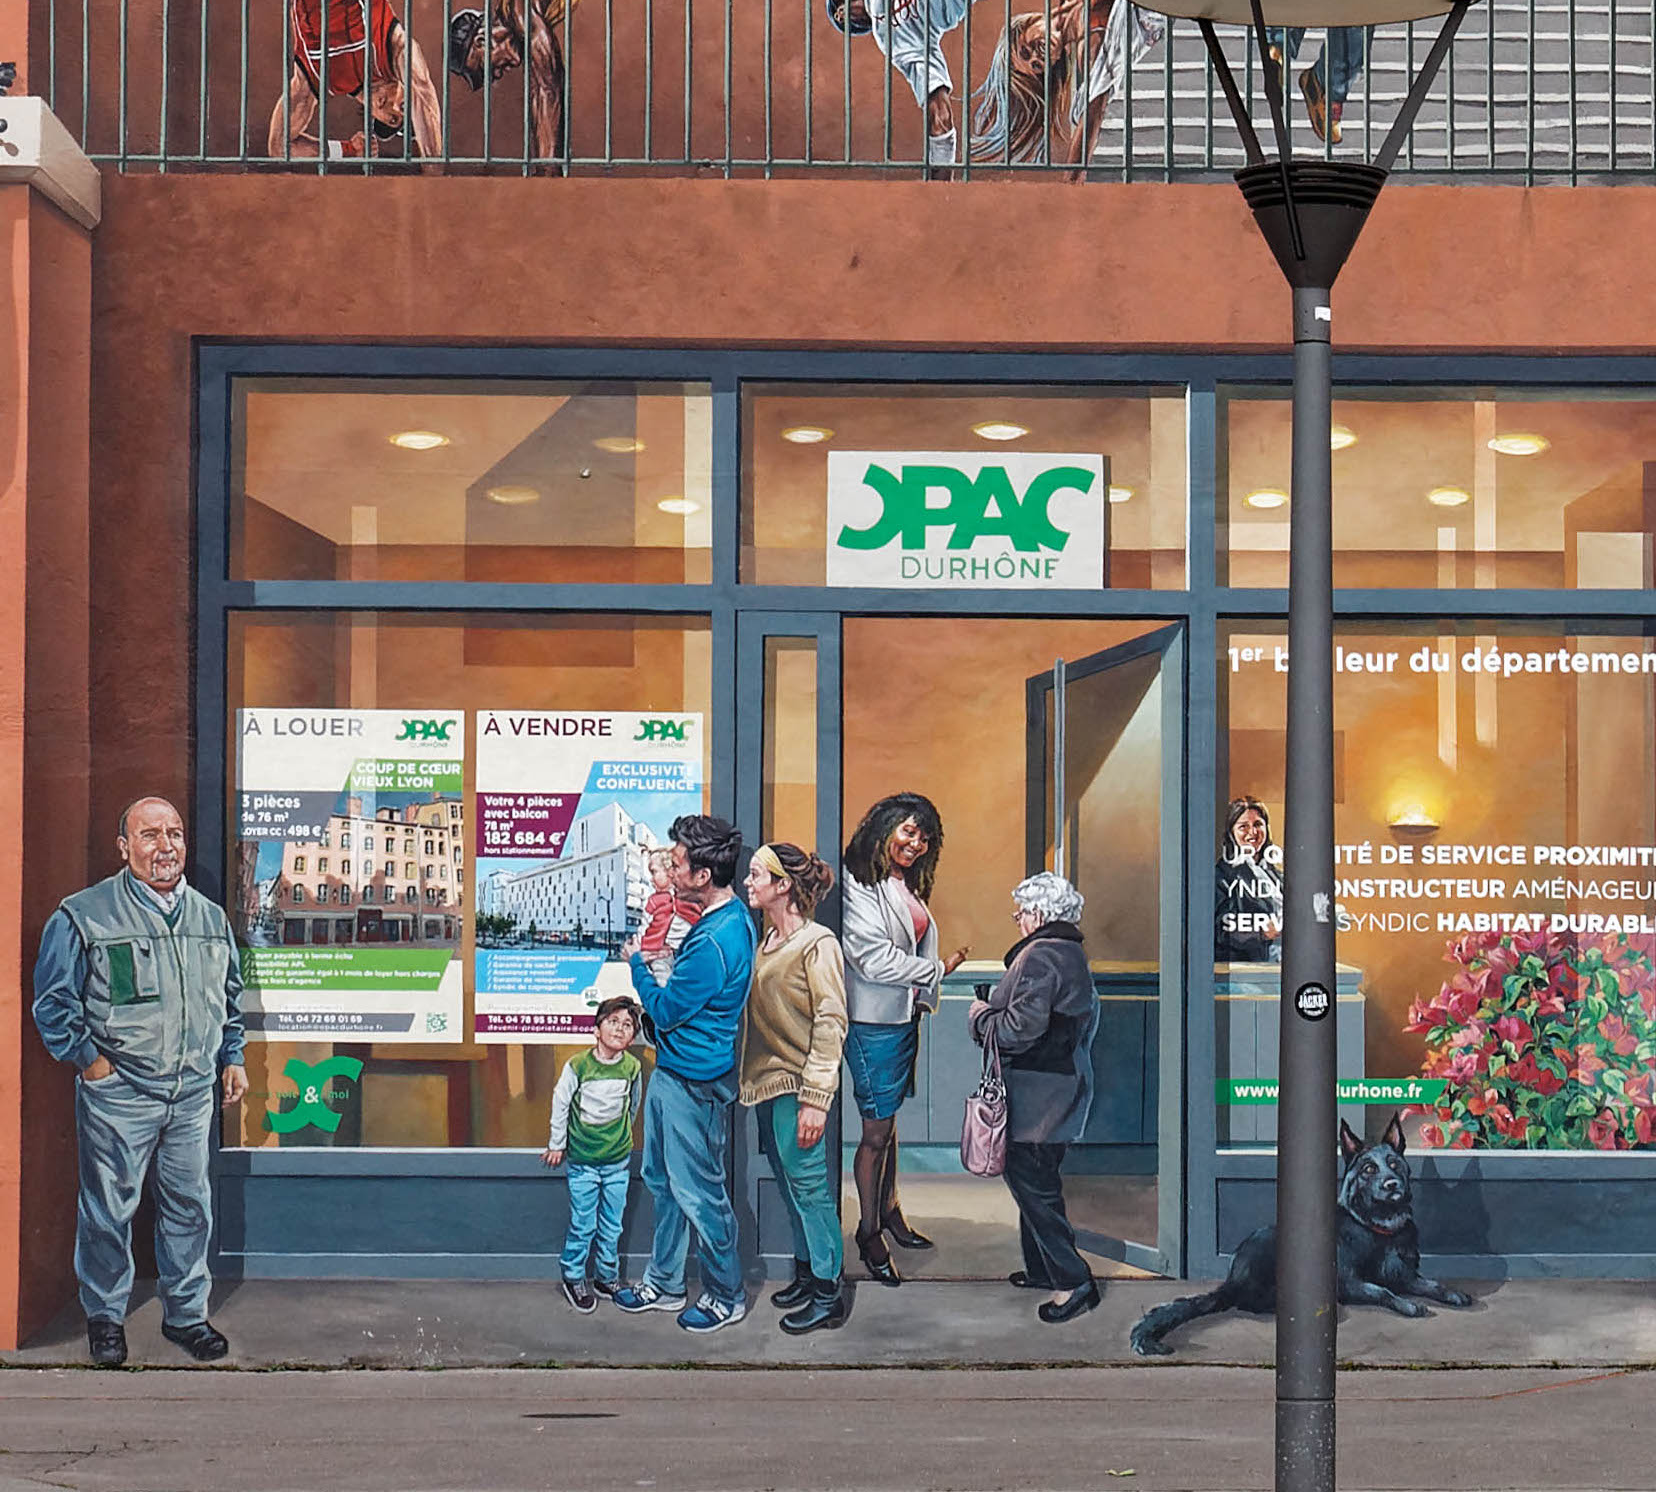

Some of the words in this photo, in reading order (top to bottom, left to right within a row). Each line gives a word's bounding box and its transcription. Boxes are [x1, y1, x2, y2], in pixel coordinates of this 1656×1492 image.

[1228, 646, 1263, 672] 1er
[1274, 646, 1397, 672] bleur
[1409, 647, 1449, 672] du
[244, 712, 262, 736] À
[274, 718, 364, 736] LOUER
[484, 712, 501, 736] À
[509, 718, 612, 736] VENDRE
[356, 763, 394, 775] COUP
[398, 763, 416, 775] DE
[352, 776, 393, 788] VIEUX
[398, 776, 434, 789] LYON
[596, 778, 695, 791] CONFLUENCE
[254, 793, 301, 810] pièces
[485, 796, 514, 807] Votre
[517, 796, 525, 807] 4
[527, 795, 563, 808] pièces
[257, 812, 272, 822] 76
[484, 810, 510, 819] avec
[512, 808, 549, 819] balcon
[287, 824, 310, 837] 498
[312, 825, 322, 837] €
[484, 821, 498, 831] 78
[484, 831, 511, 845] 182
[514, 831, 545, 845] 684
[484, 846, 500, 855] hors
[1380, 847, 1414, 865] DE
[1421, 846, 1526, 866] SERVICE
[1337, 912, 1430, 932] SYNDIC
[1437, 912, 1545, 933] HABITAT
[296, 1014, 309, 1024] 04
[311, 1014, 322, 1024] 72
[323, 1014, 336, 1024] 69
[337, 1014, 349, 1024] 01
[520, 1015, 531, 1024] 78
[304, 1085, 319, 1104] &
